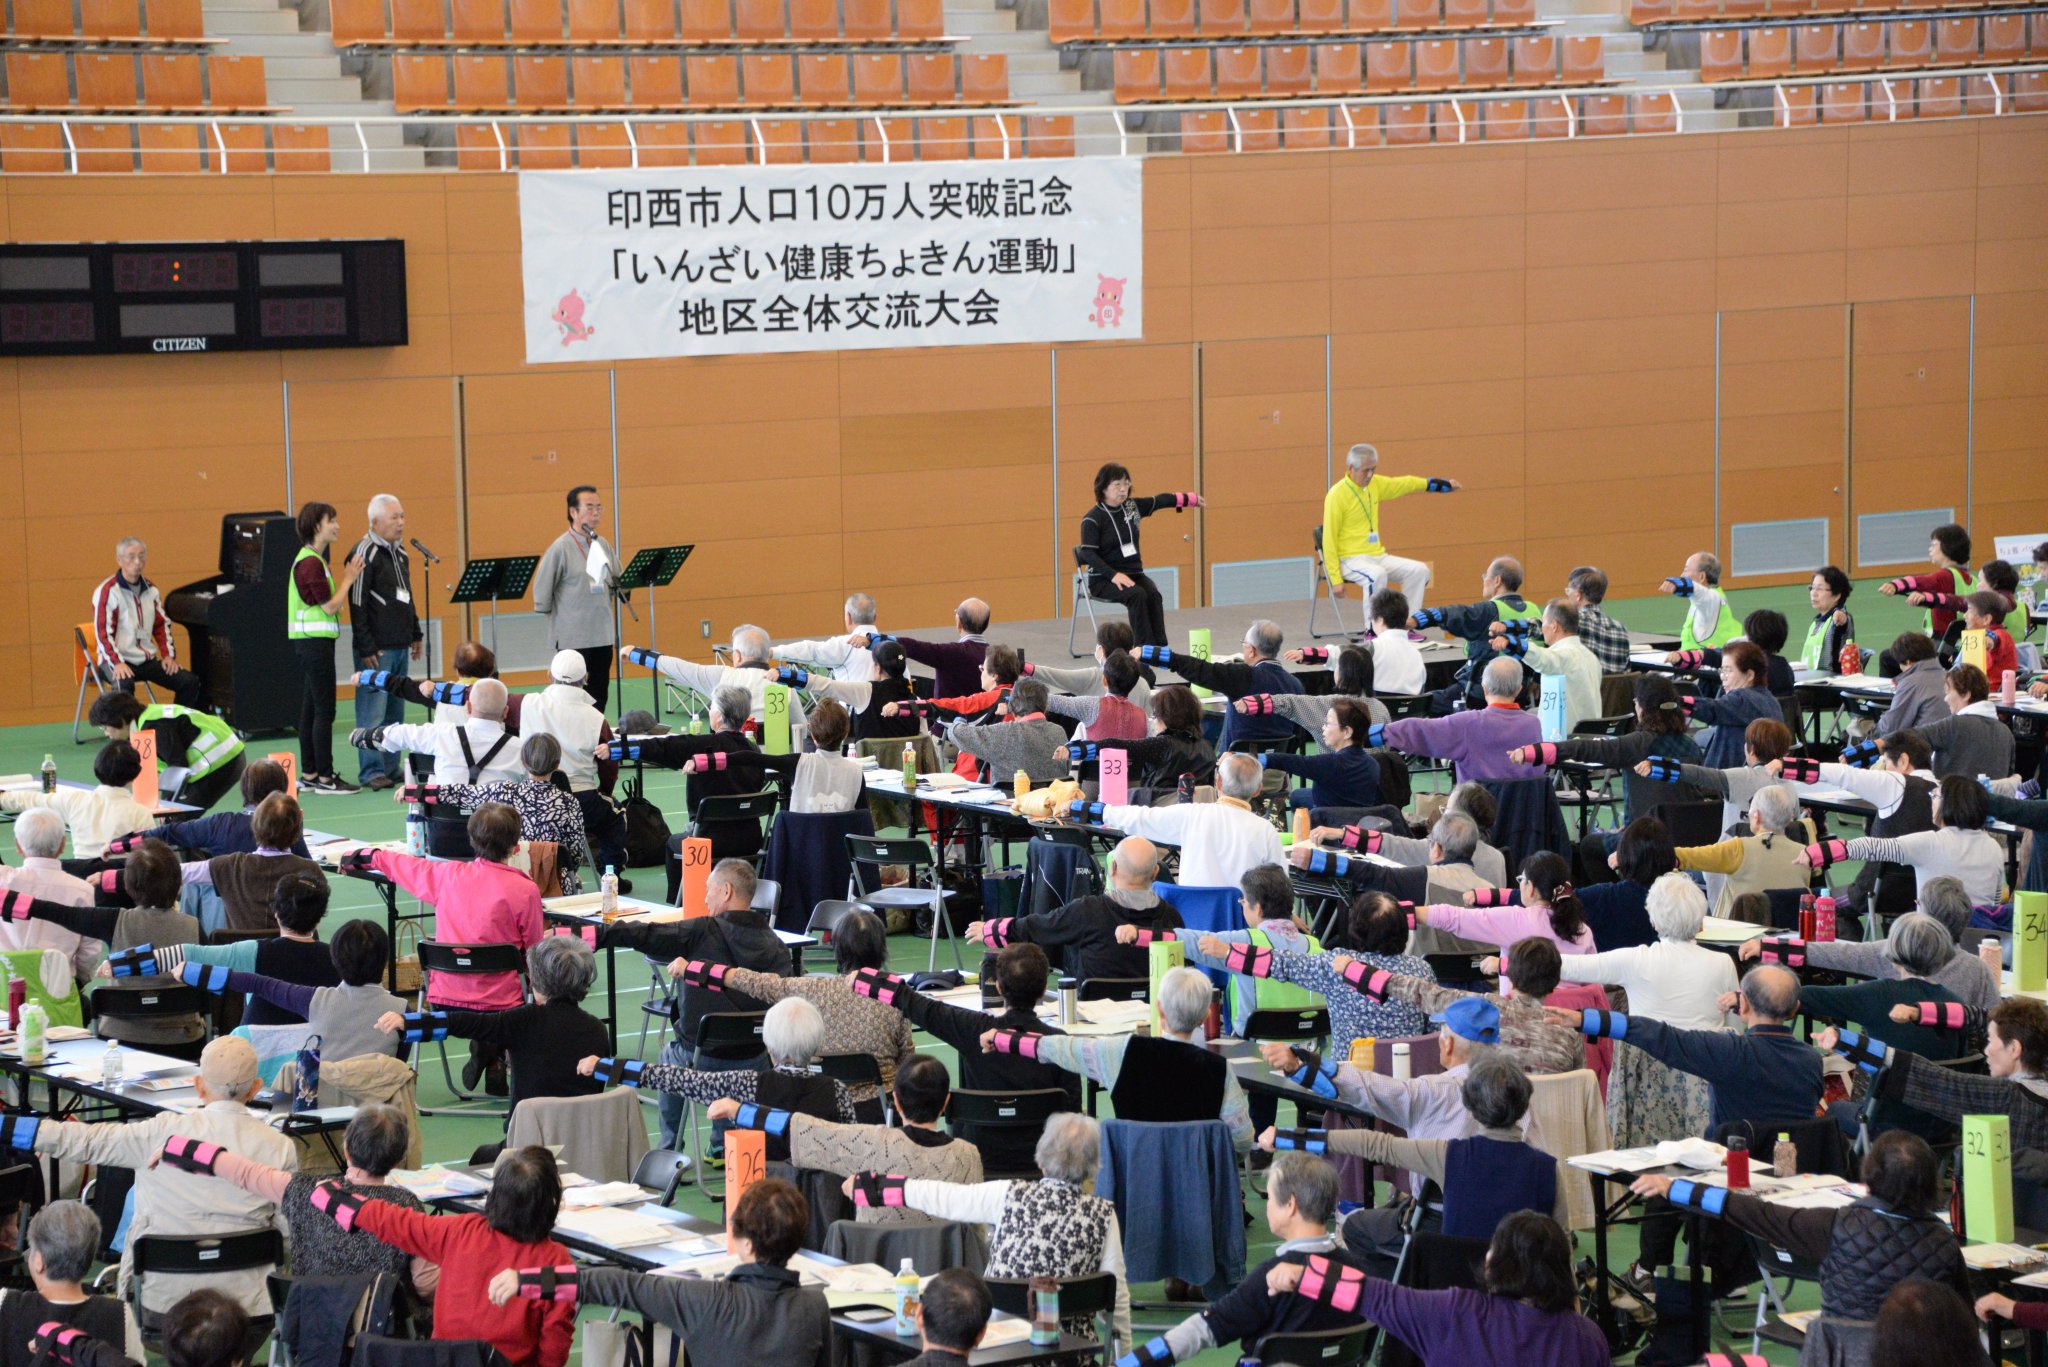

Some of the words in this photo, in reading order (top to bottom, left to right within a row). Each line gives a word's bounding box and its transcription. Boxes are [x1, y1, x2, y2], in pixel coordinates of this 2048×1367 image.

[607, 175, 1074, 229] 印西市人口10万人突破記念
[612, 238, 1077, 285] 「いんざい健康ちょきん運動」
[679, 288, 1001, 336] 地区全体交流大会
[153, 337, 207, 352] CITIZEN
[1191, 644, 1209, 660] 38
[767, 692, 785, 715] 33
[1543, 691, 1557, 710] 39
[1104, 759, 1122, 775] 33
[685, 845, 709, 867] 30
[2025, 913, 2047, 942] 34
[1966, 1131, 1985, 1157] 32
[741, 1148, 765, 1187] 26
